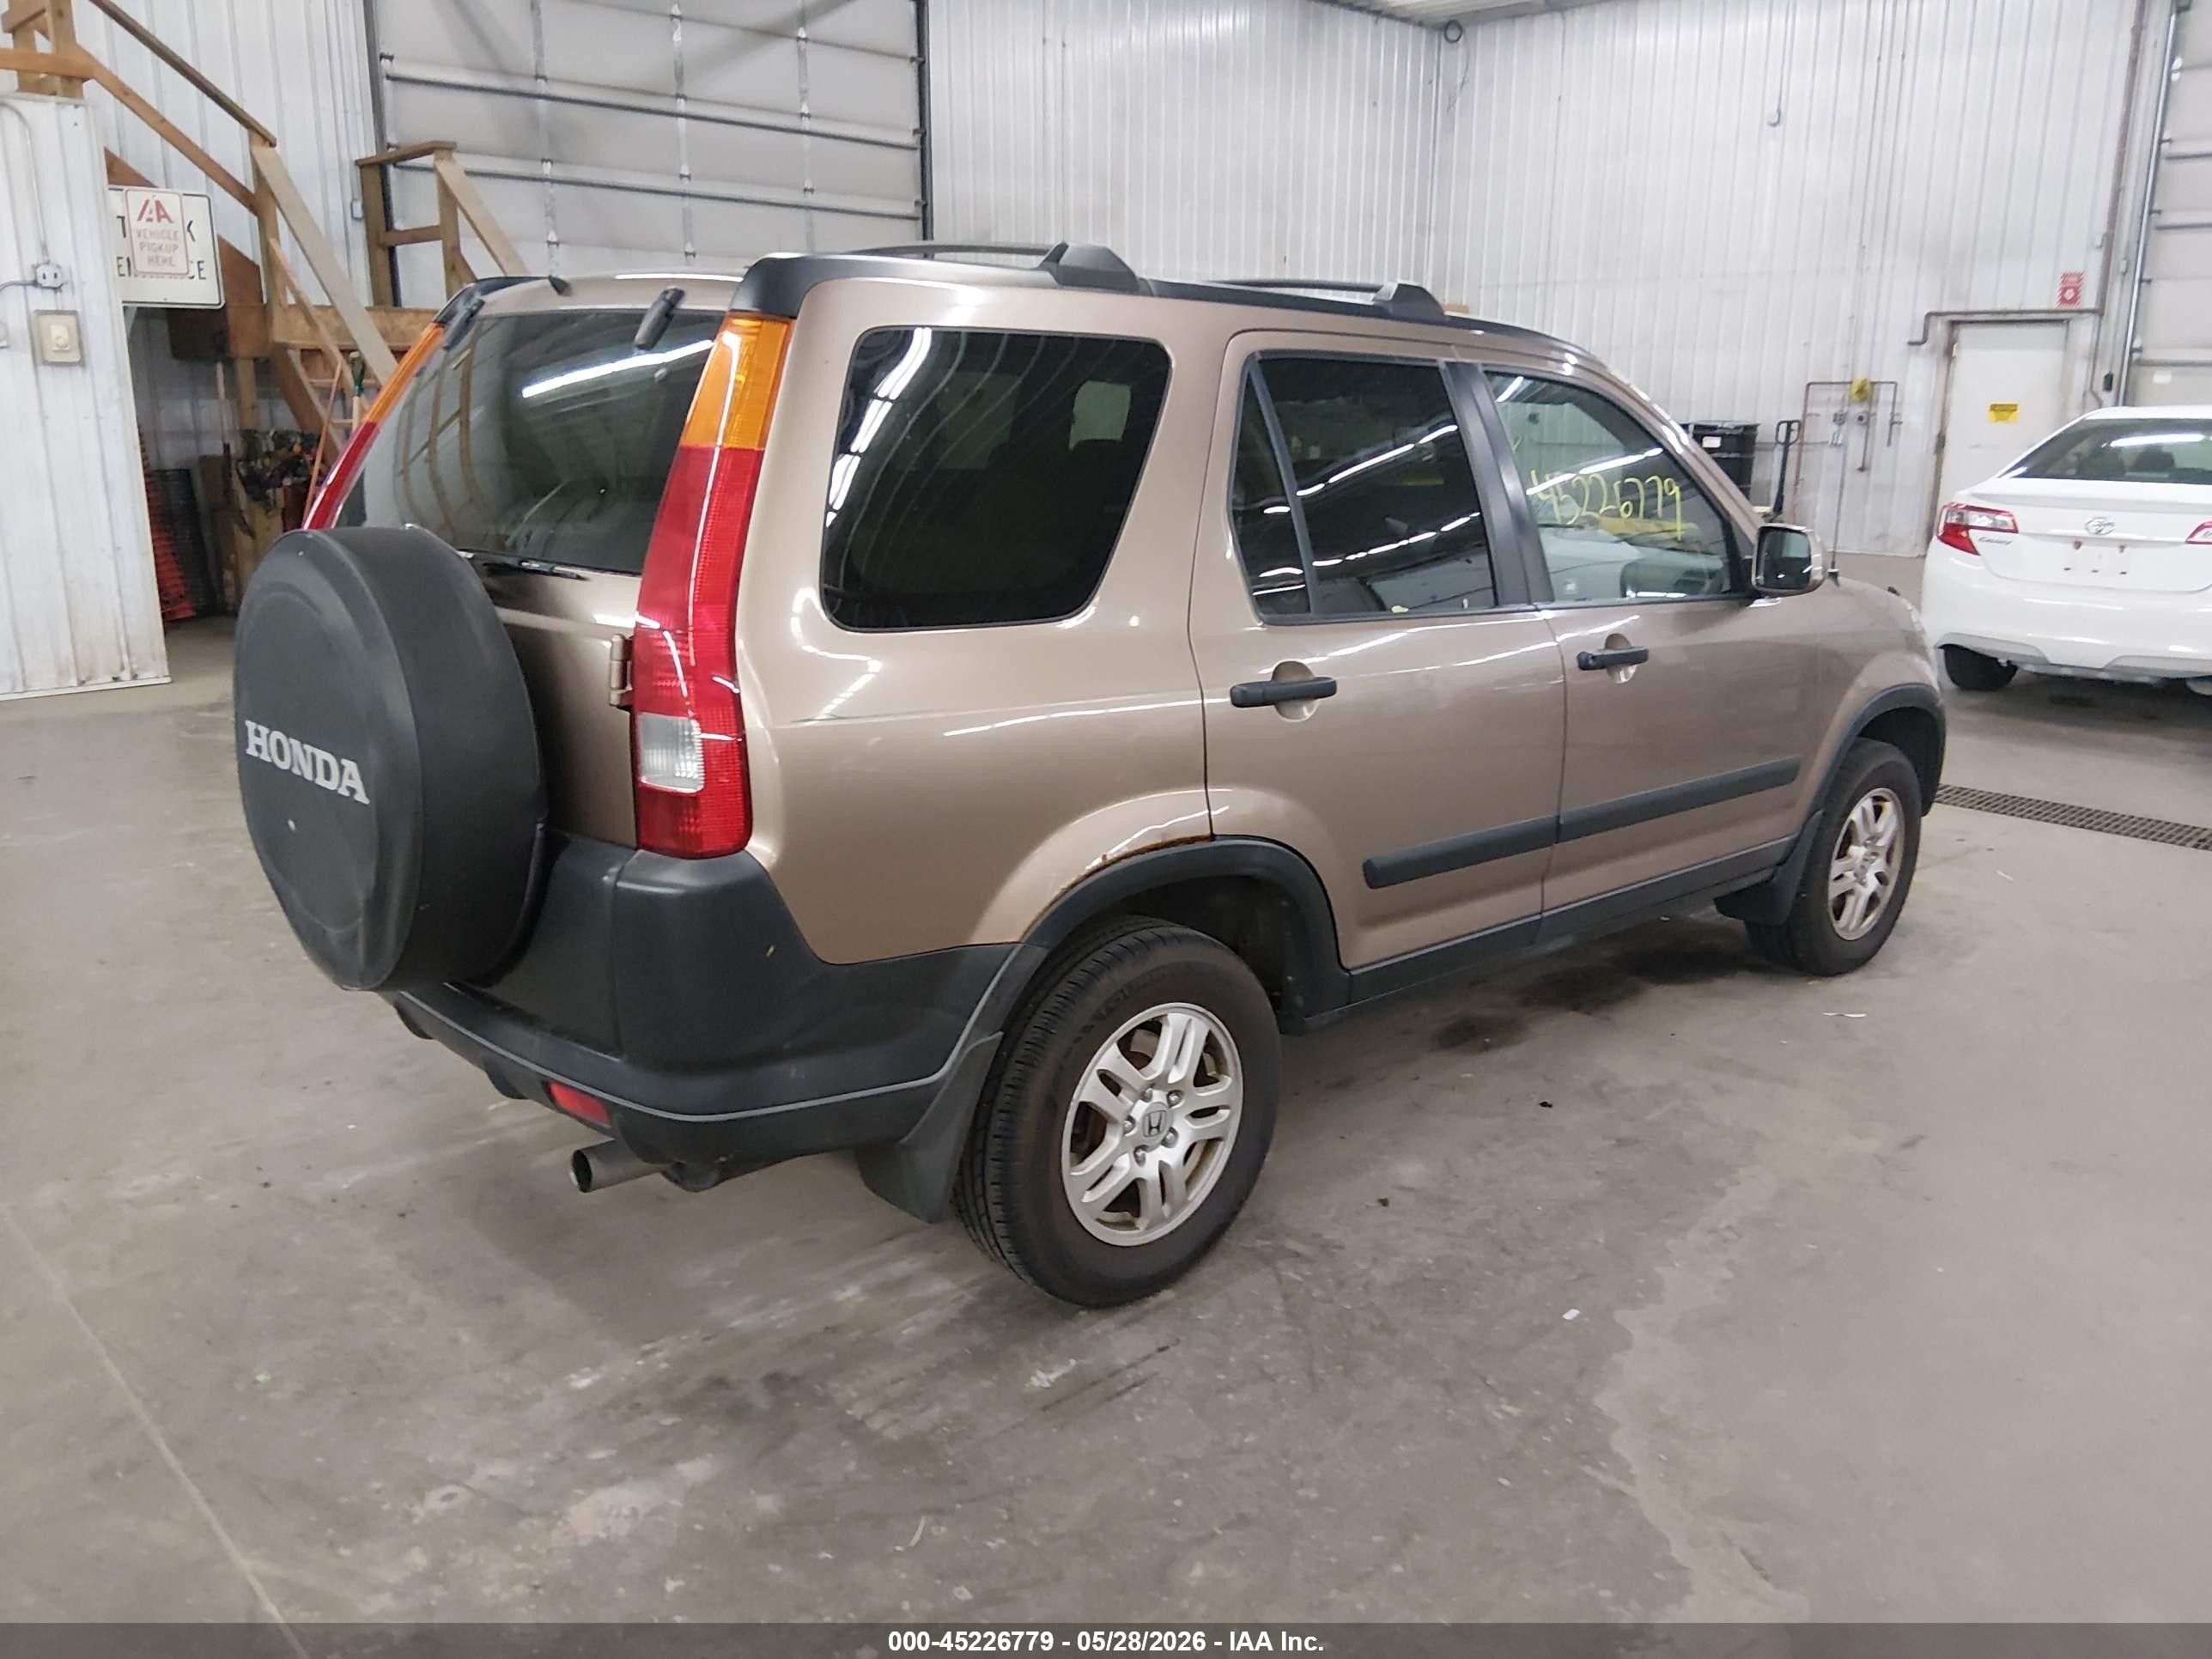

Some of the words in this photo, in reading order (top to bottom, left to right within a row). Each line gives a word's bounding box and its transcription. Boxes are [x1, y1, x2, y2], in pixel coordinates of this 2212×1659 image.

[137, 228, 179, 241] VEHICLE
[1530, 470, 1683, 544] 45226779
[245, 720, 370, 805] HONDA
